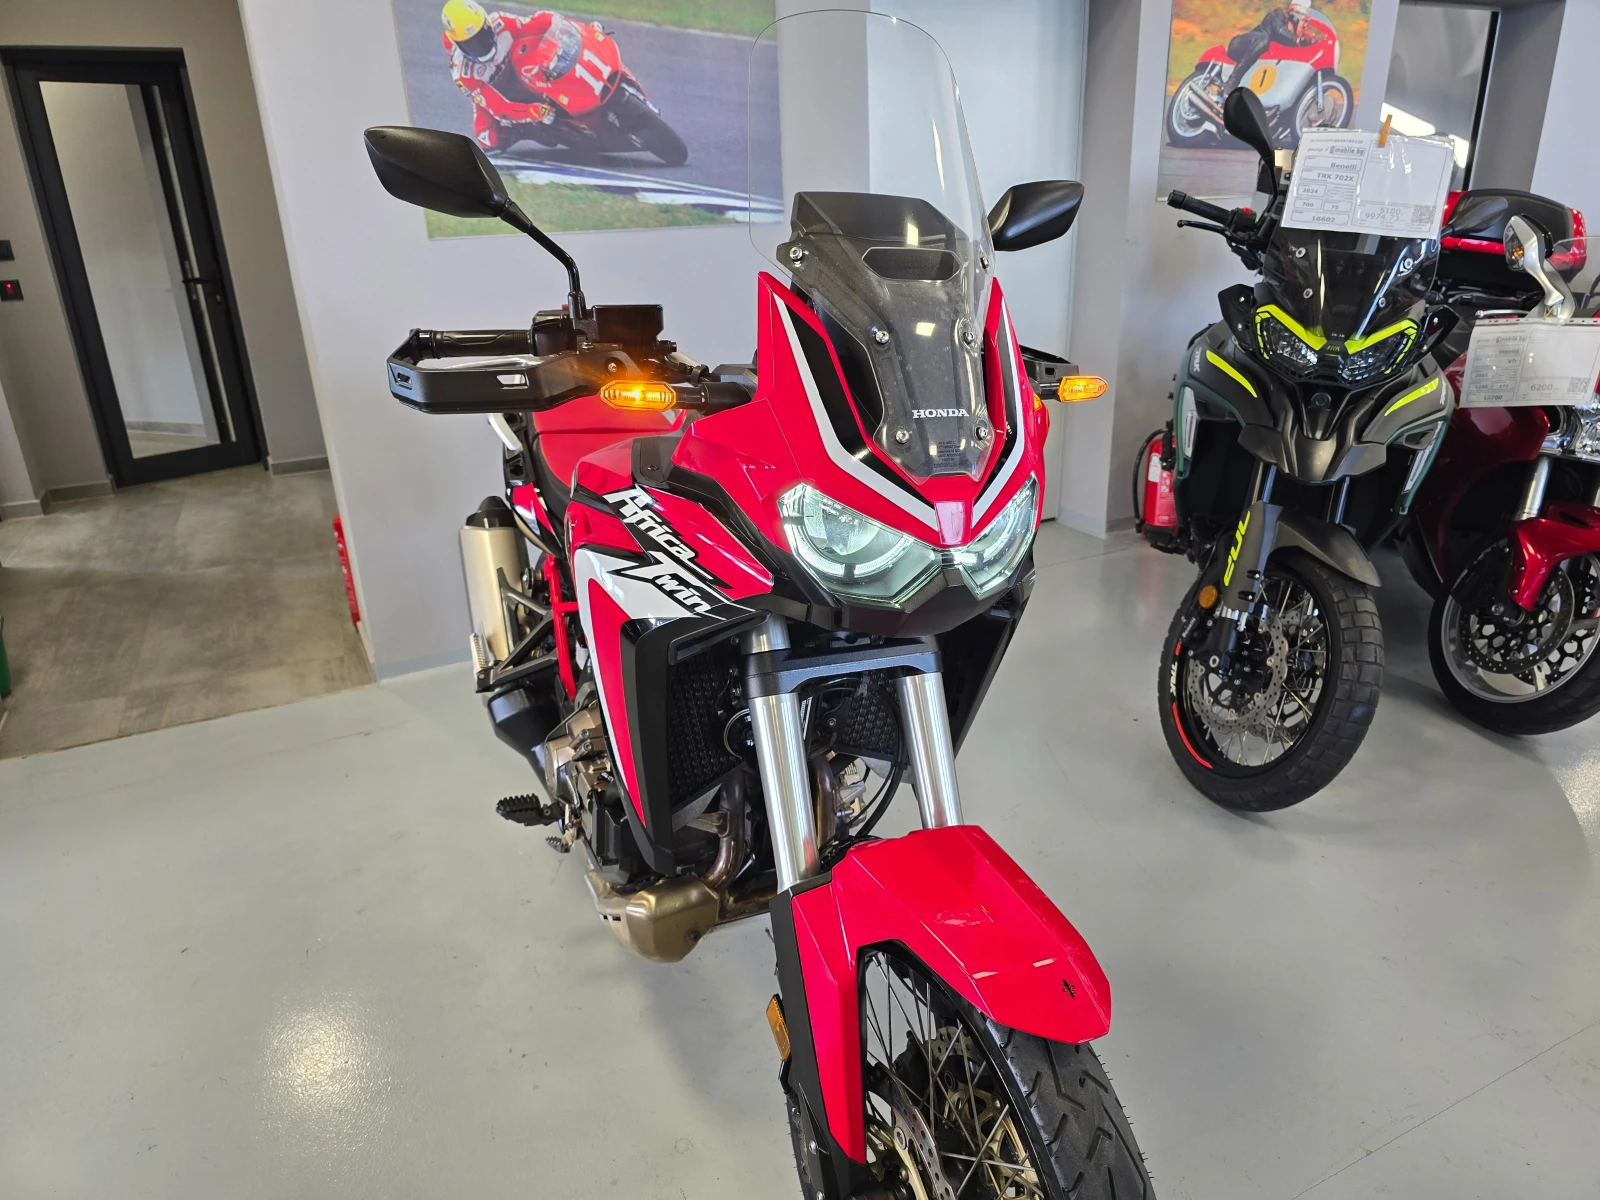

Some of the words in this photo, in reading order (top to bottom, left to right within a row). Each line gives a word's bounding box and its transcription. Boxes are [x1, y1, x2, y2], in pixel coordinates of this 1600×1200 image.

[575, 50, 612, 96] 11
[1259, 69, 1268, 88] 1
[1330, 162, 1358, 170] Benelli
[1317, 172, 1333, 180] TRK
[1334, 174, 1355, 182] 702X
[1312, 215, 1336, 223] 16602
[1530, 383, 1553, 392] 6200
[911, 408, 970, 419] HONDA
[602, 483, 708, 572] Africa
[621, 550, 728, 616] Twin
